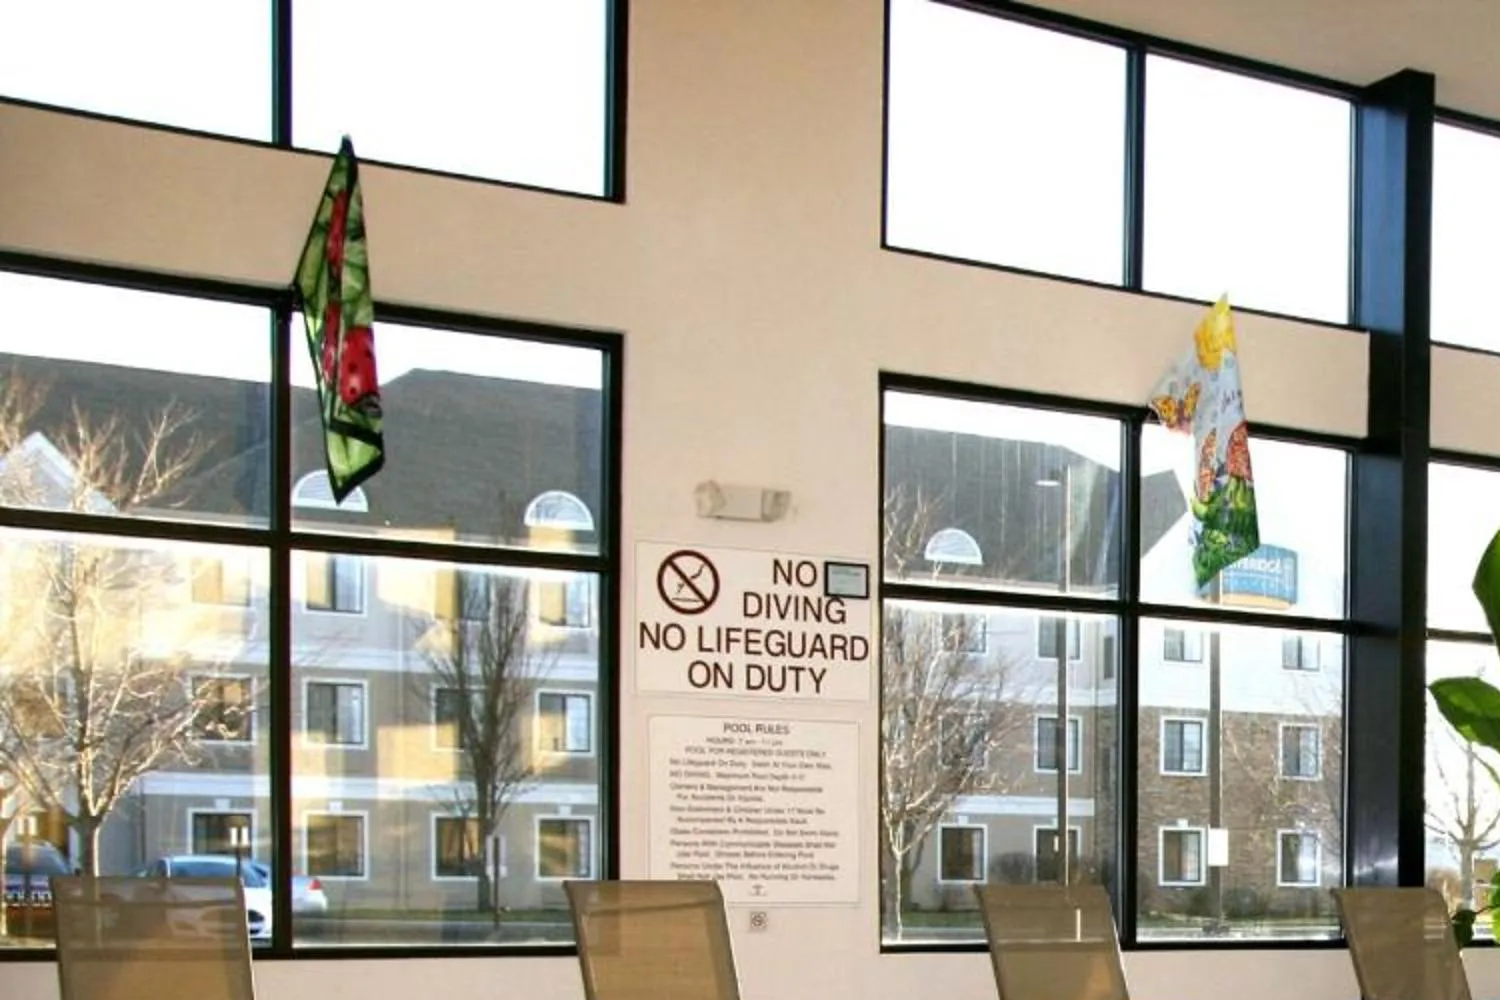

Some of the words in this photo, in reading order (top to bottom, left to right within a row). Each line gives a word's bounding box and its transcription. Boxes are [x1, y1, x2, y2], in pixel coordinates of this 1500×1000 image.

[773, 559, 817, 588] NO
[743, 592, 847, 624] DIVING
[639, 622, 686, 651] NO
[698, 626, 869, 661] LIFEGUARD
[688, 660, 733, 688] ON
[746, 664, 828, 694] DUTY
[723, 723, 751, 733] POOL
[755, 724, 790, 735] RULES
